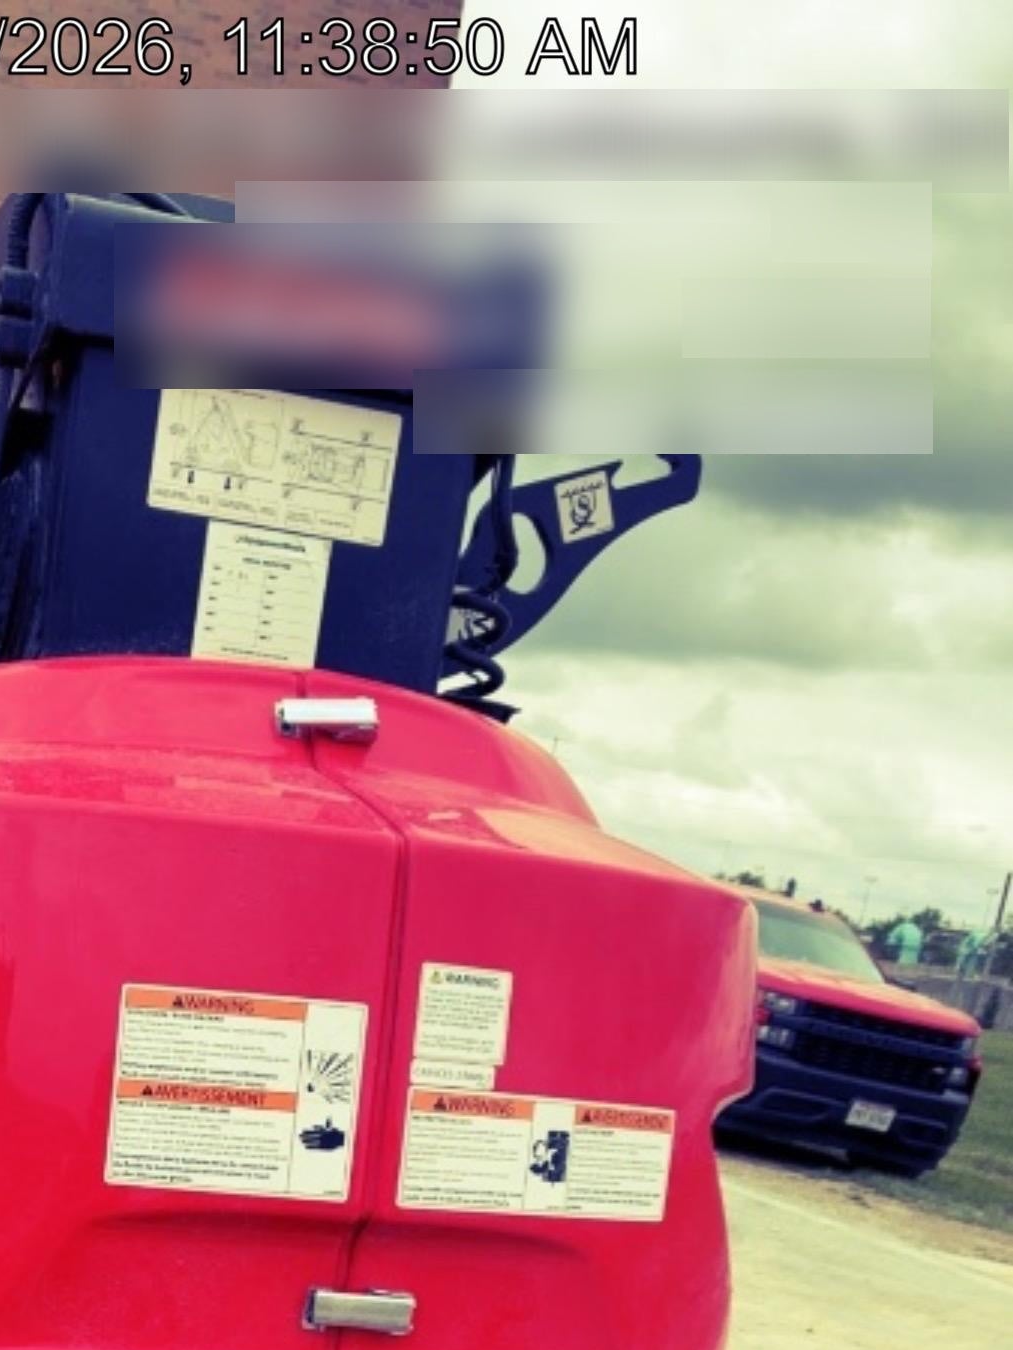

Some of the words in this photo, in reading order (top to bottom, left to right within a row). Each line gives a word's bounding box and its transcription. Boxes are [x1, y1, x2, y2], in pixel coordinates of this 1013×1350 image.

[445, 973, 500, 989] WARNING
[184, 995, 255, 1014] WARNING
[153, 1083, 268, 1106] AVERTISSEMENT
[447, 1099, 517, 1118] WARNING
